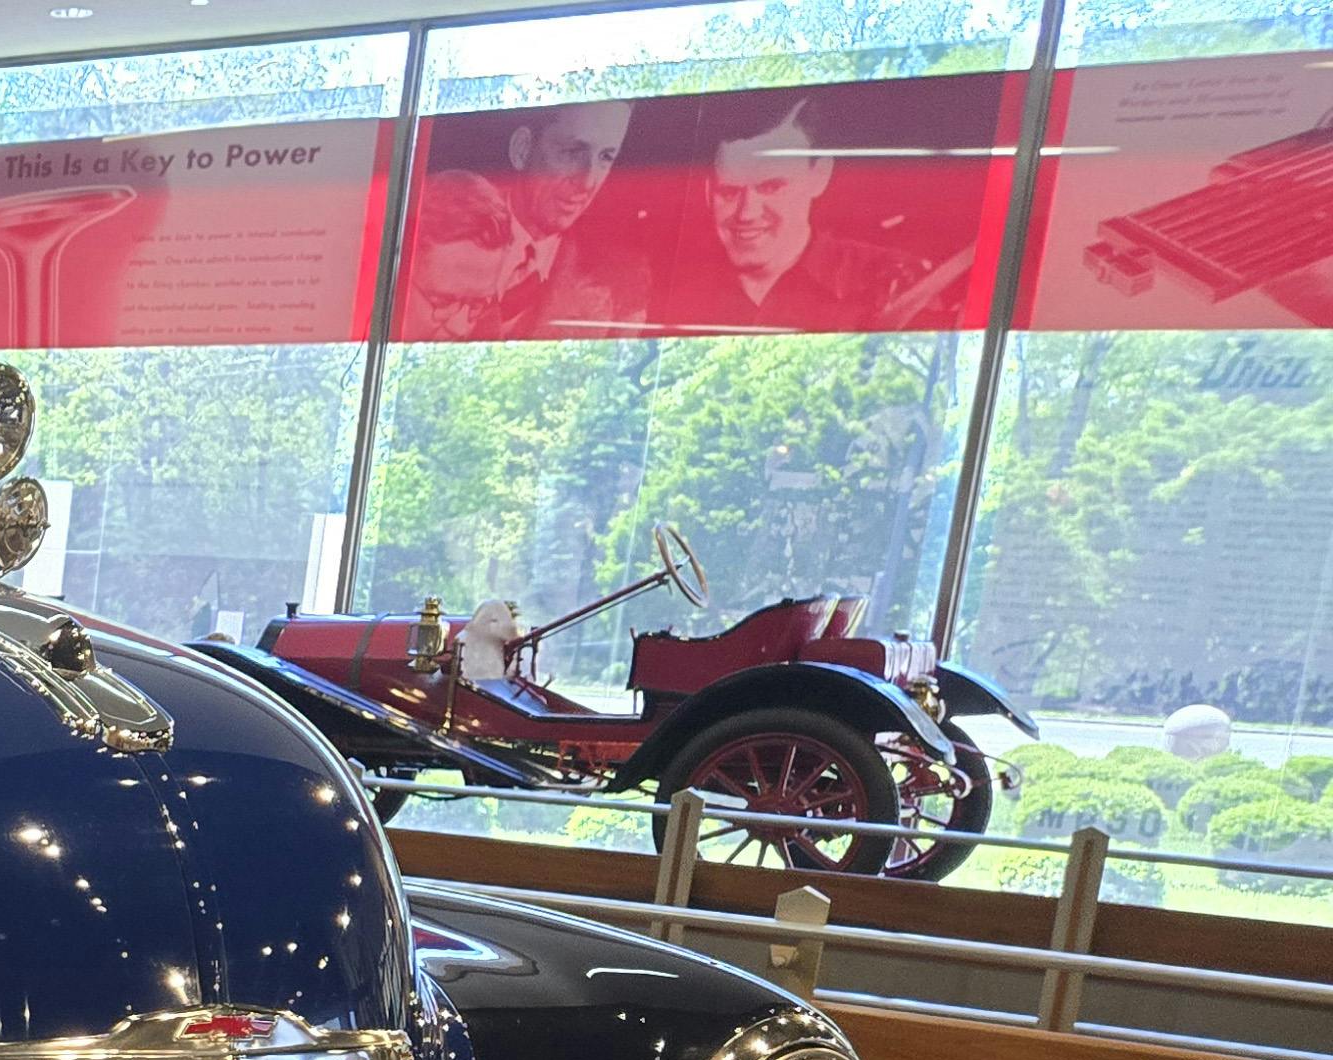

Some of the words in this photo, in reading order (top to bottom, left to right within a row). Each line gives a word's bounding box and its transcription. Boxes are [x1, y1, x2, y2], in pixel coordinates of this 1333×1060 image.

[5, 152, 53, 179] This
[63, 152, 83, 176] Is
[93, 156, 110, 174] a
[120, 150, 175, 177] Key
[186, 149, 215, 170] to
[226, 144, 322, 168] Power
